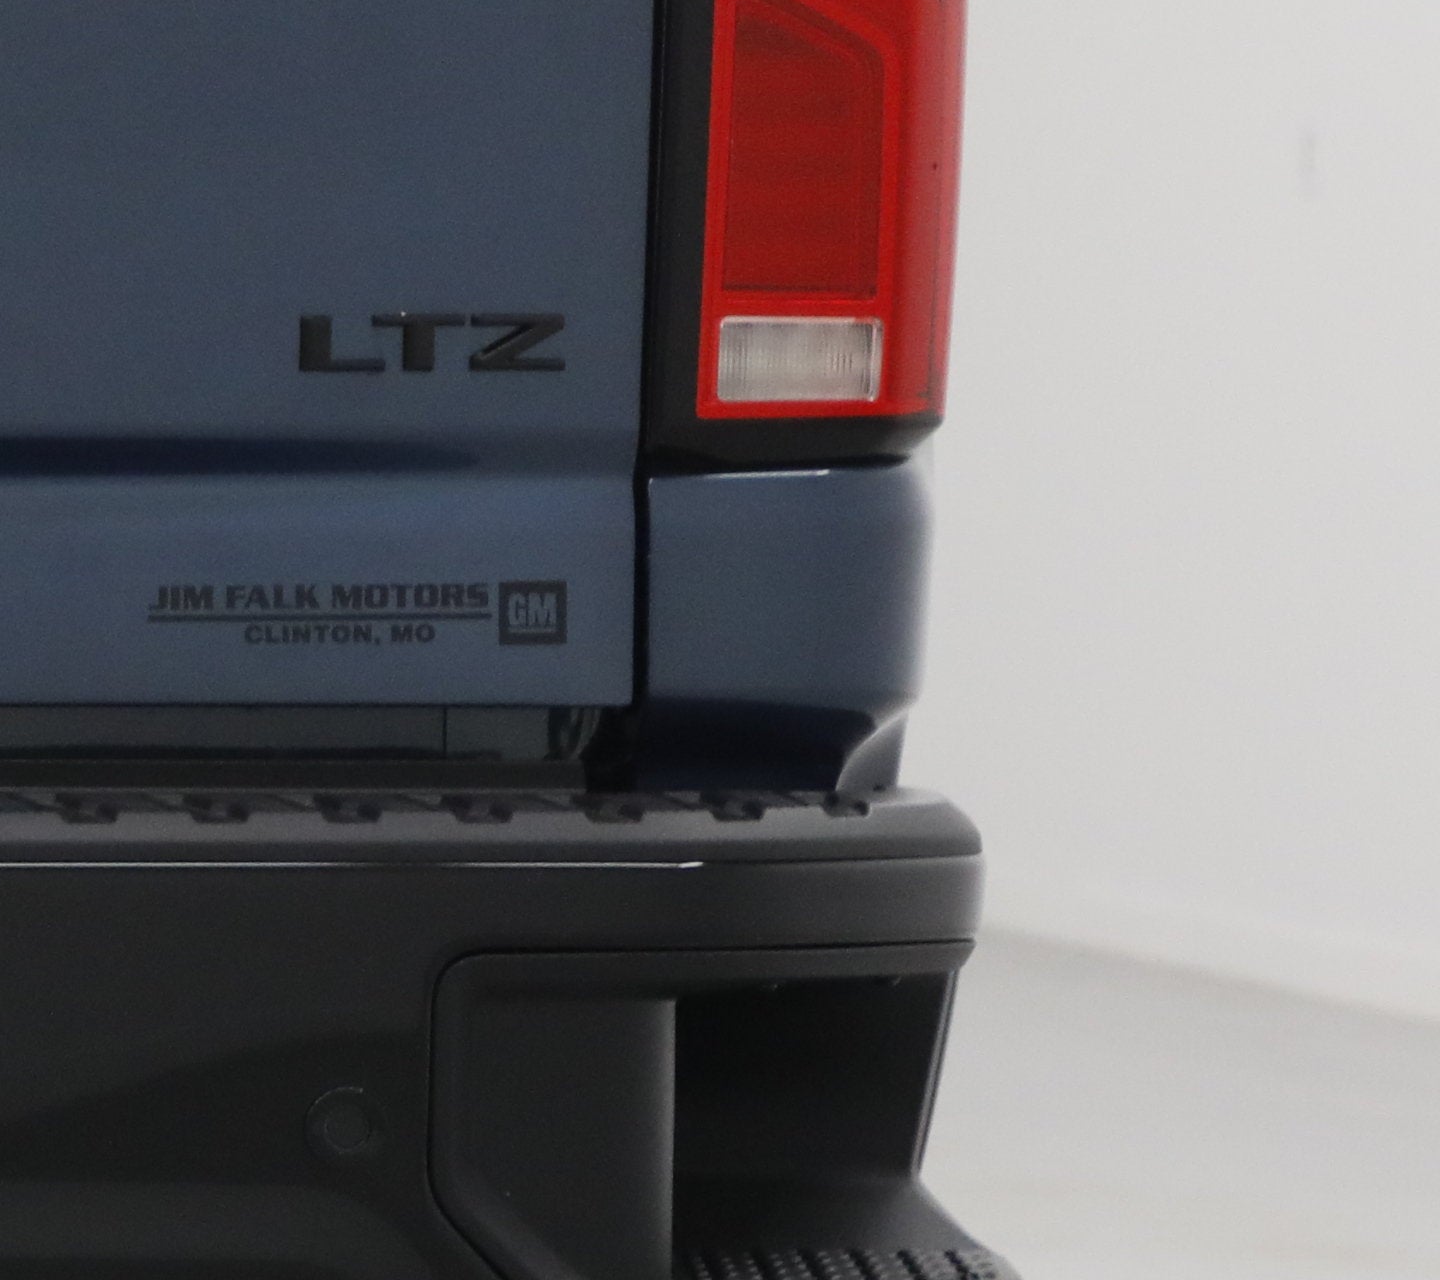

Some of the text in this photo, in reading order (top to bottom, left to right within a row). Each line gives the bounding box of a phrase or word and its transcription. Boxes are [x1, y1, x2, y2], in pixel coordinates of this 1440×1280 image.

[299, 313, 566, 372] LTZ
[148, 583, 490, 612] JIM FALK MOTORS
[390, 624, 437, 645] MO
